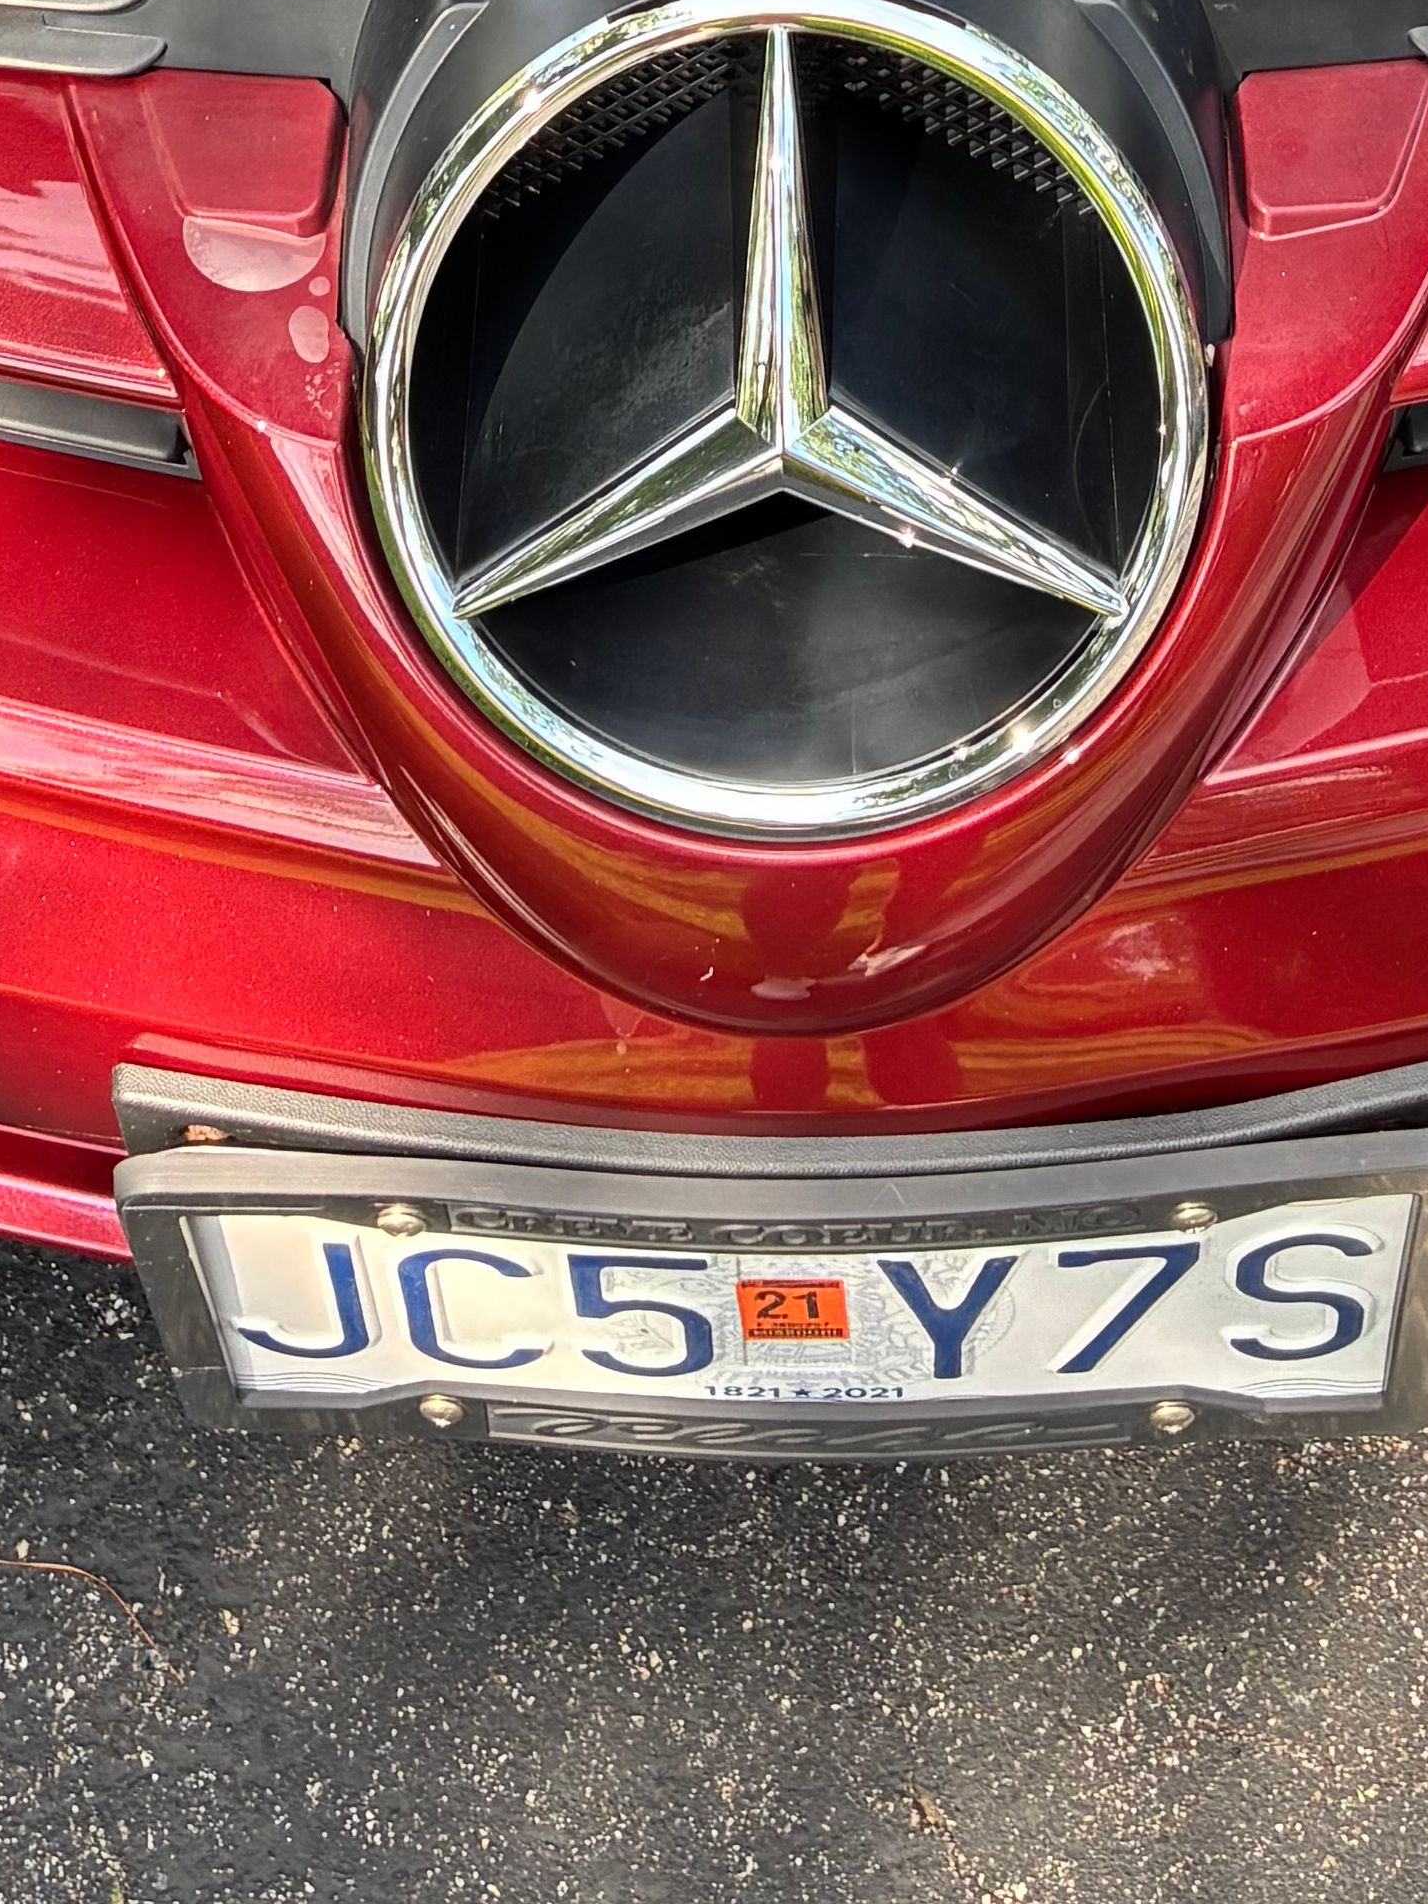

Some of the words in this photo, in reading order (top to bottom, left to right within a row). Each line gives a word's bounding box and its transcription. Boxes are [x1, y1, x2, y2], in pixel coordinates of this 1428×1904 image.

[1013, 1203, 1145, 1239] MO
[237, 1242, 714, 1378] JC5
[876, 1223, 1366, 1382] Y7S
[755, 1290, 820, 1320] 21
[704, 1385, 781, 1399] 1821
[823, 1386, 904, 1400] 2021
